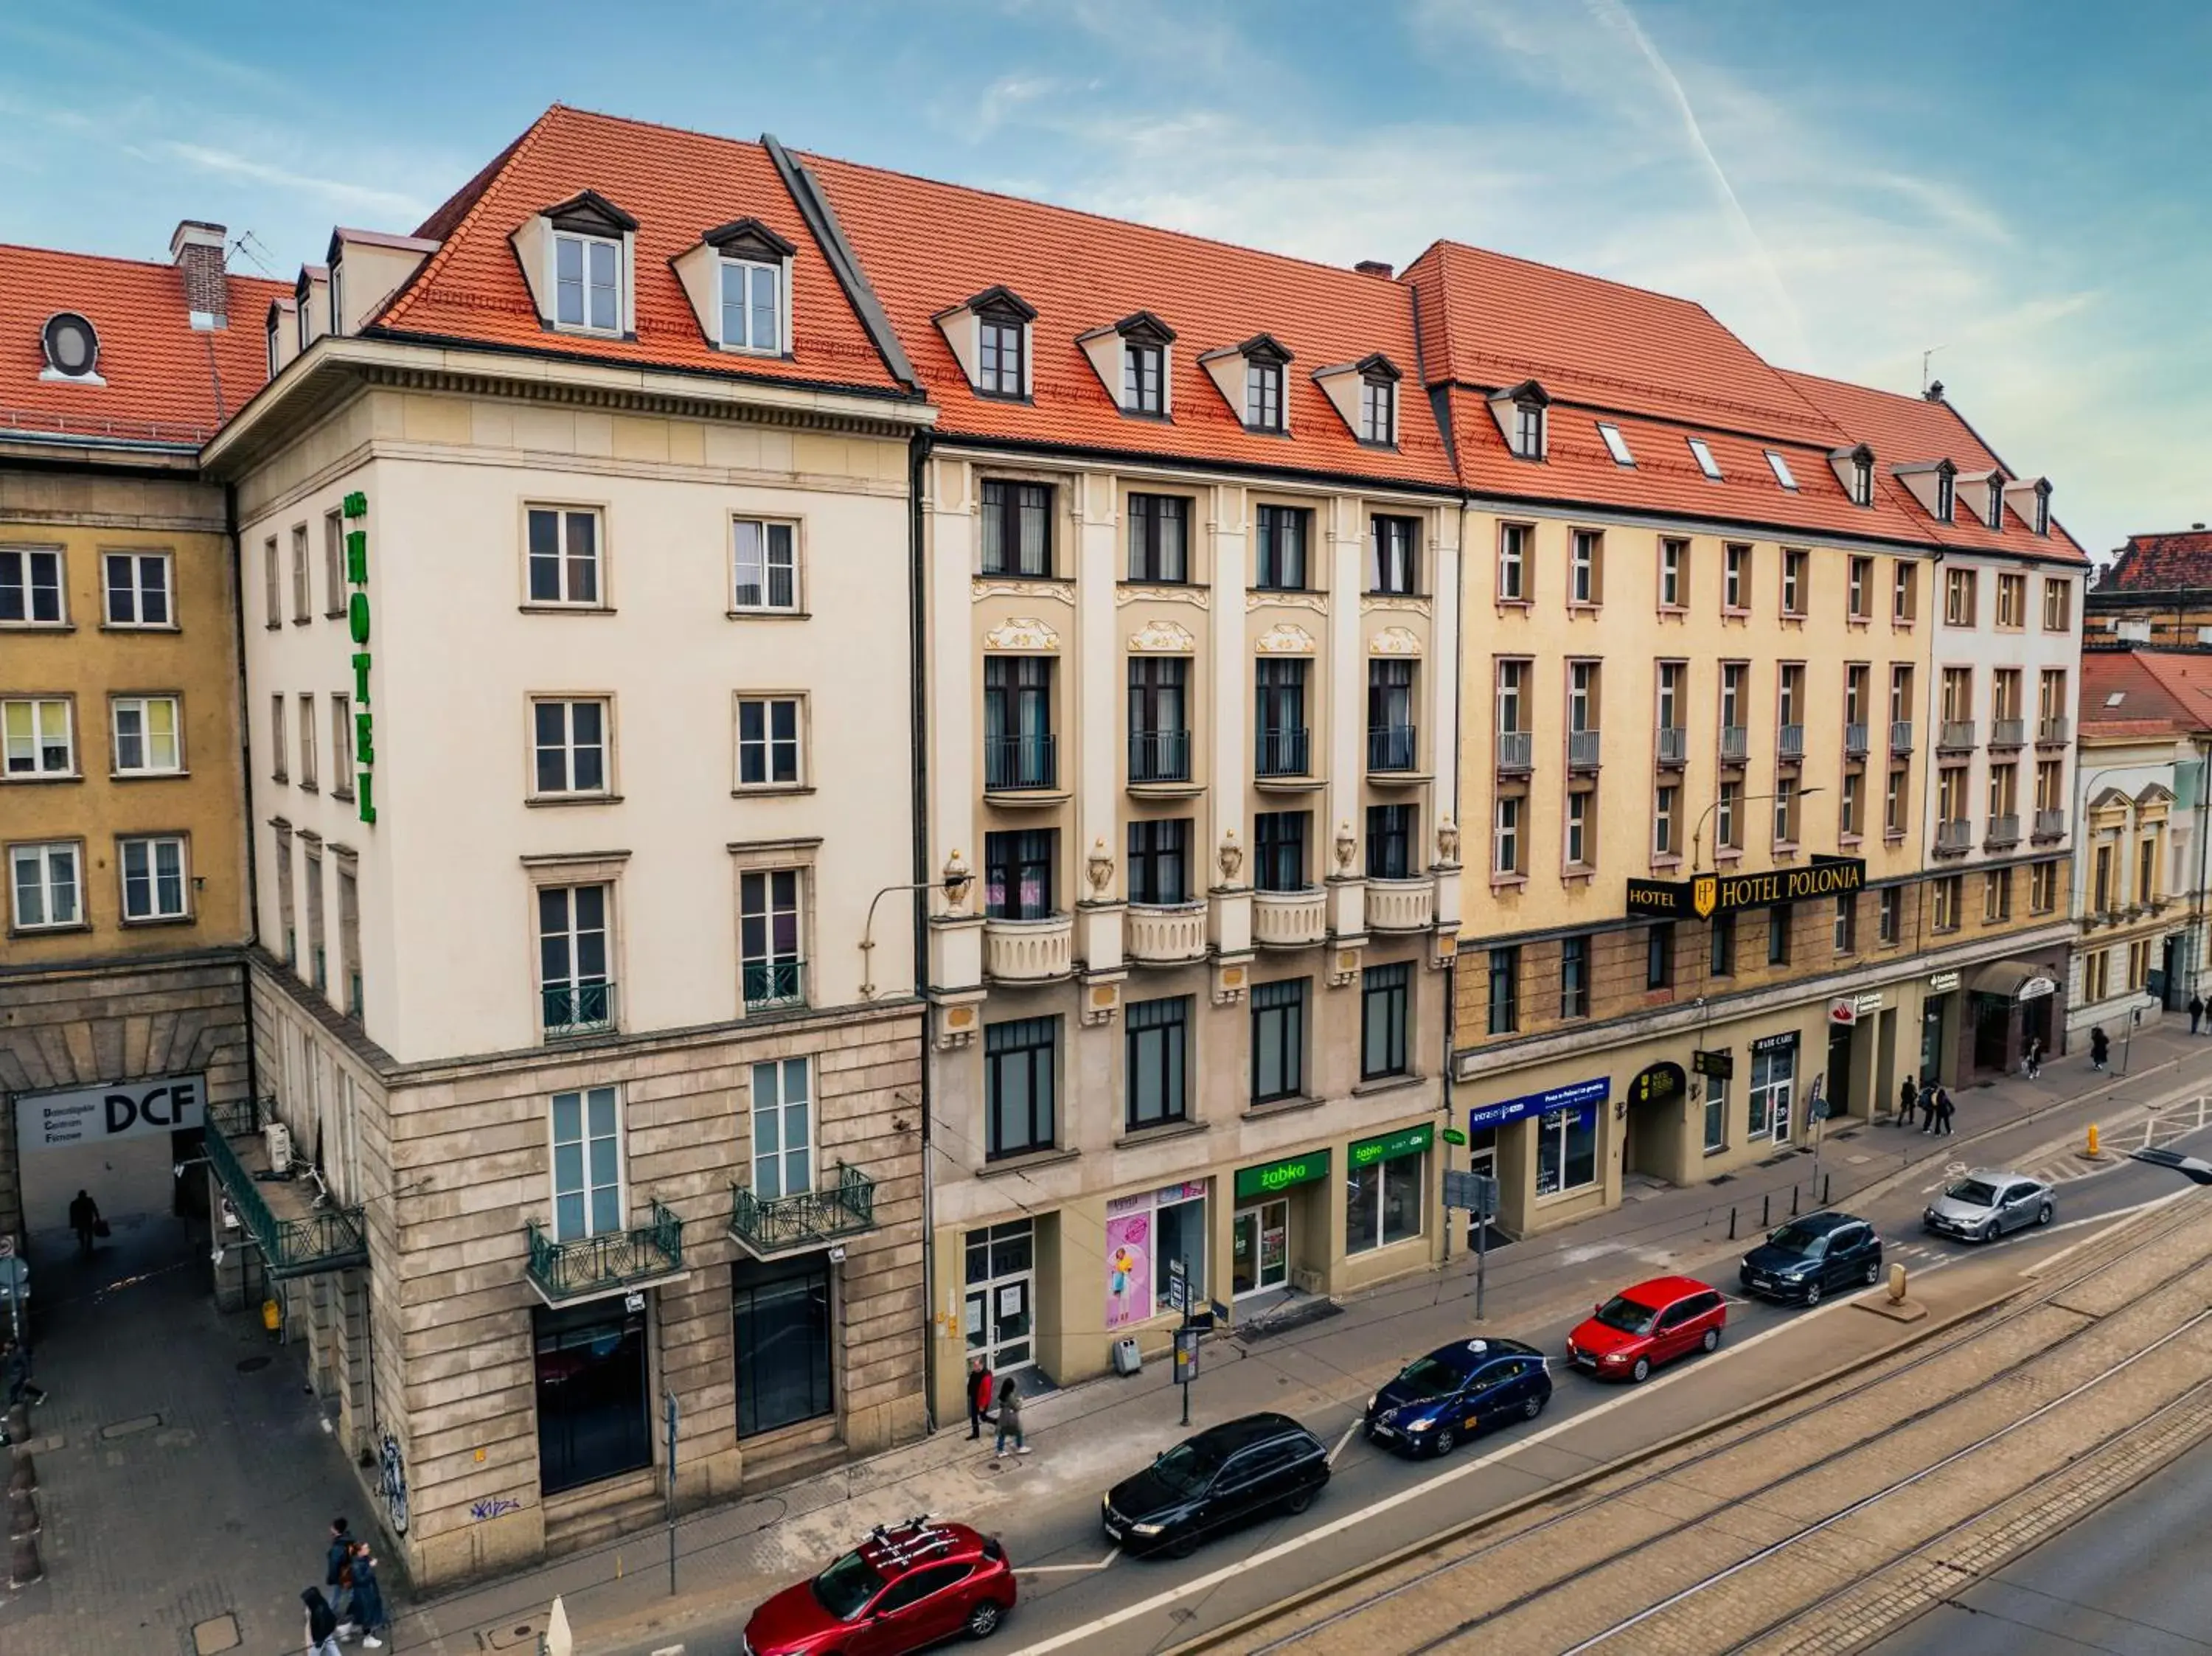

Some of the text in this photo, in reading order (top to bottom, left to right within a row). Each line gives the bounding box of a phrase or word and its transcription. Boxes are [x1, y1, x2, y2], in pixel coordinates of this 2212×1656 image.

[346, 529, 377, 824] HOTEL
[1630, 888, 1676, 908] HOTEL
[1722, 866, 1859, 908] HOTEL POLONIA
[104, 1084, 195, 1134] DCF
[1356, 1144, 1382, 1158] żabka
[1261, 1163, 1306, 1186] żabka
